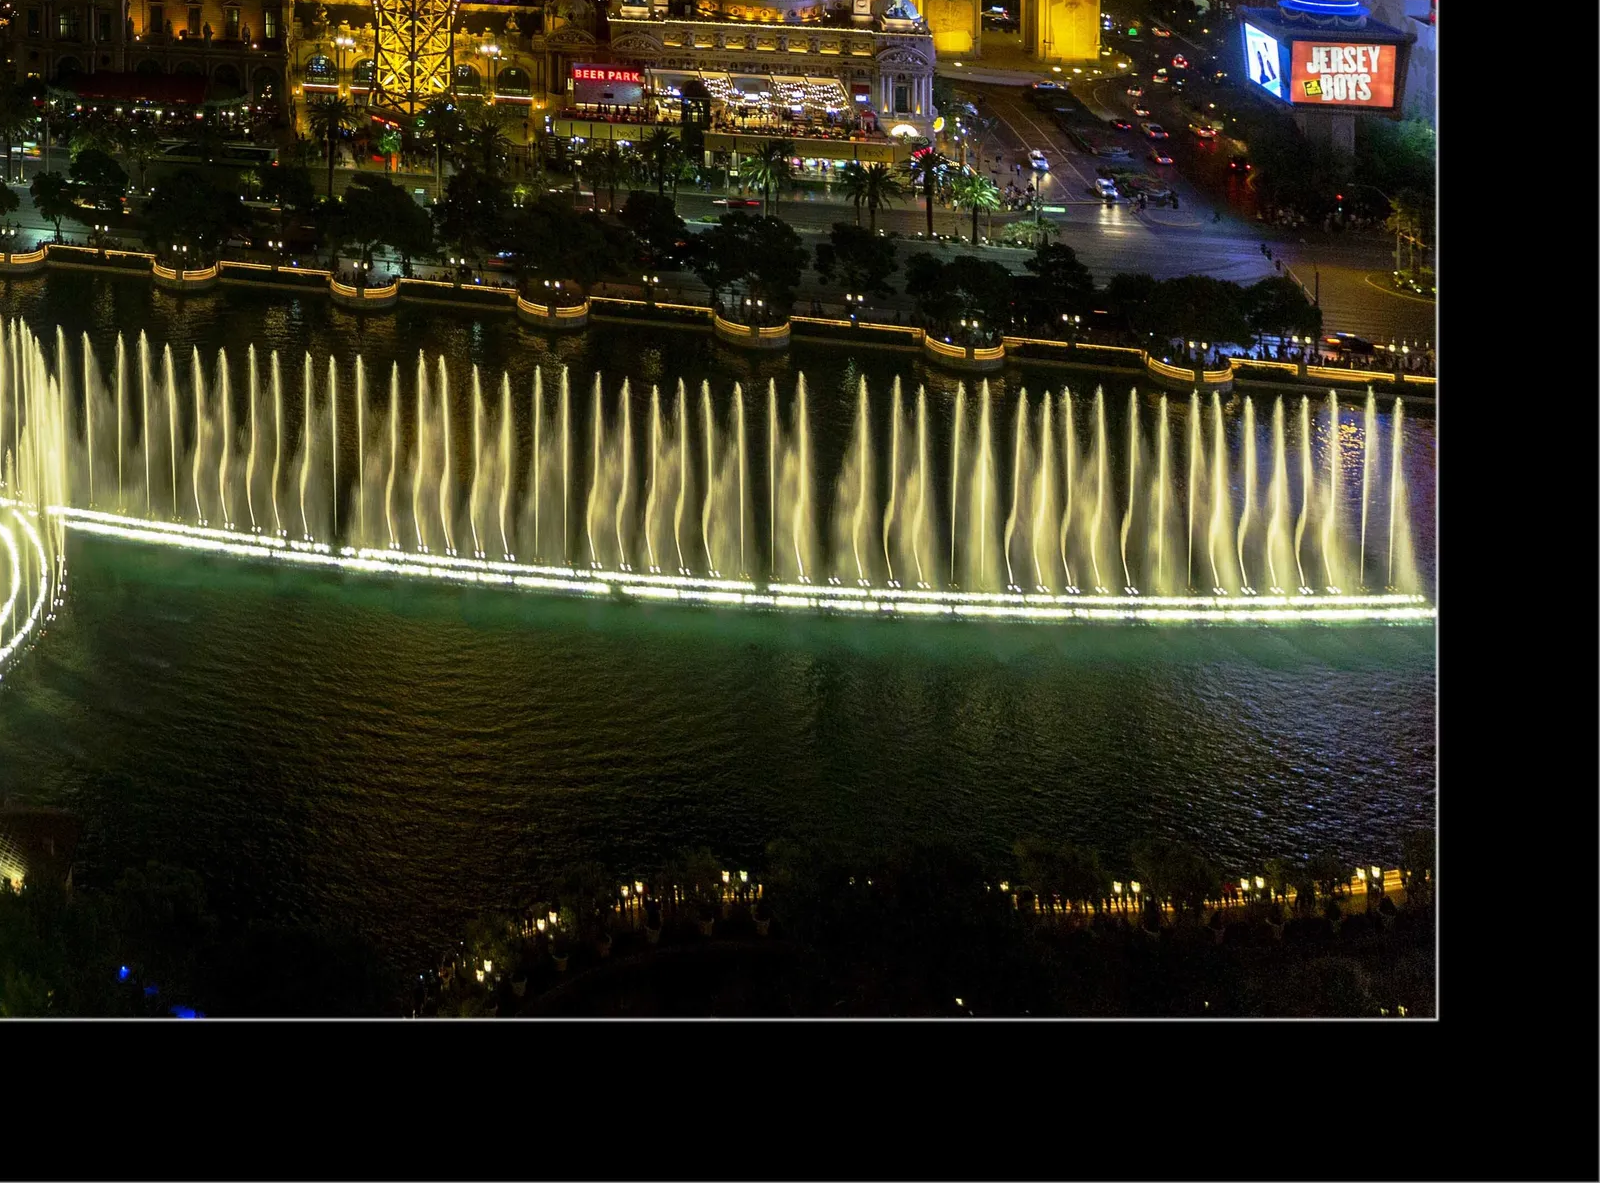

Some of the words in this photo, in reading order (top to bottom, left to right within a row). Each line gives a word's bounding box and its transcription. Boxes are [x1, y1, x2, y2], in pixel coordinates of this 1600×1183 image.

[1306, 46, 1380, 73] JERSEY
[575, 70, 605, 80] BEER
[607, 72, 640, 82] PARK
[1320, 74, 1372, 101] BOYS
